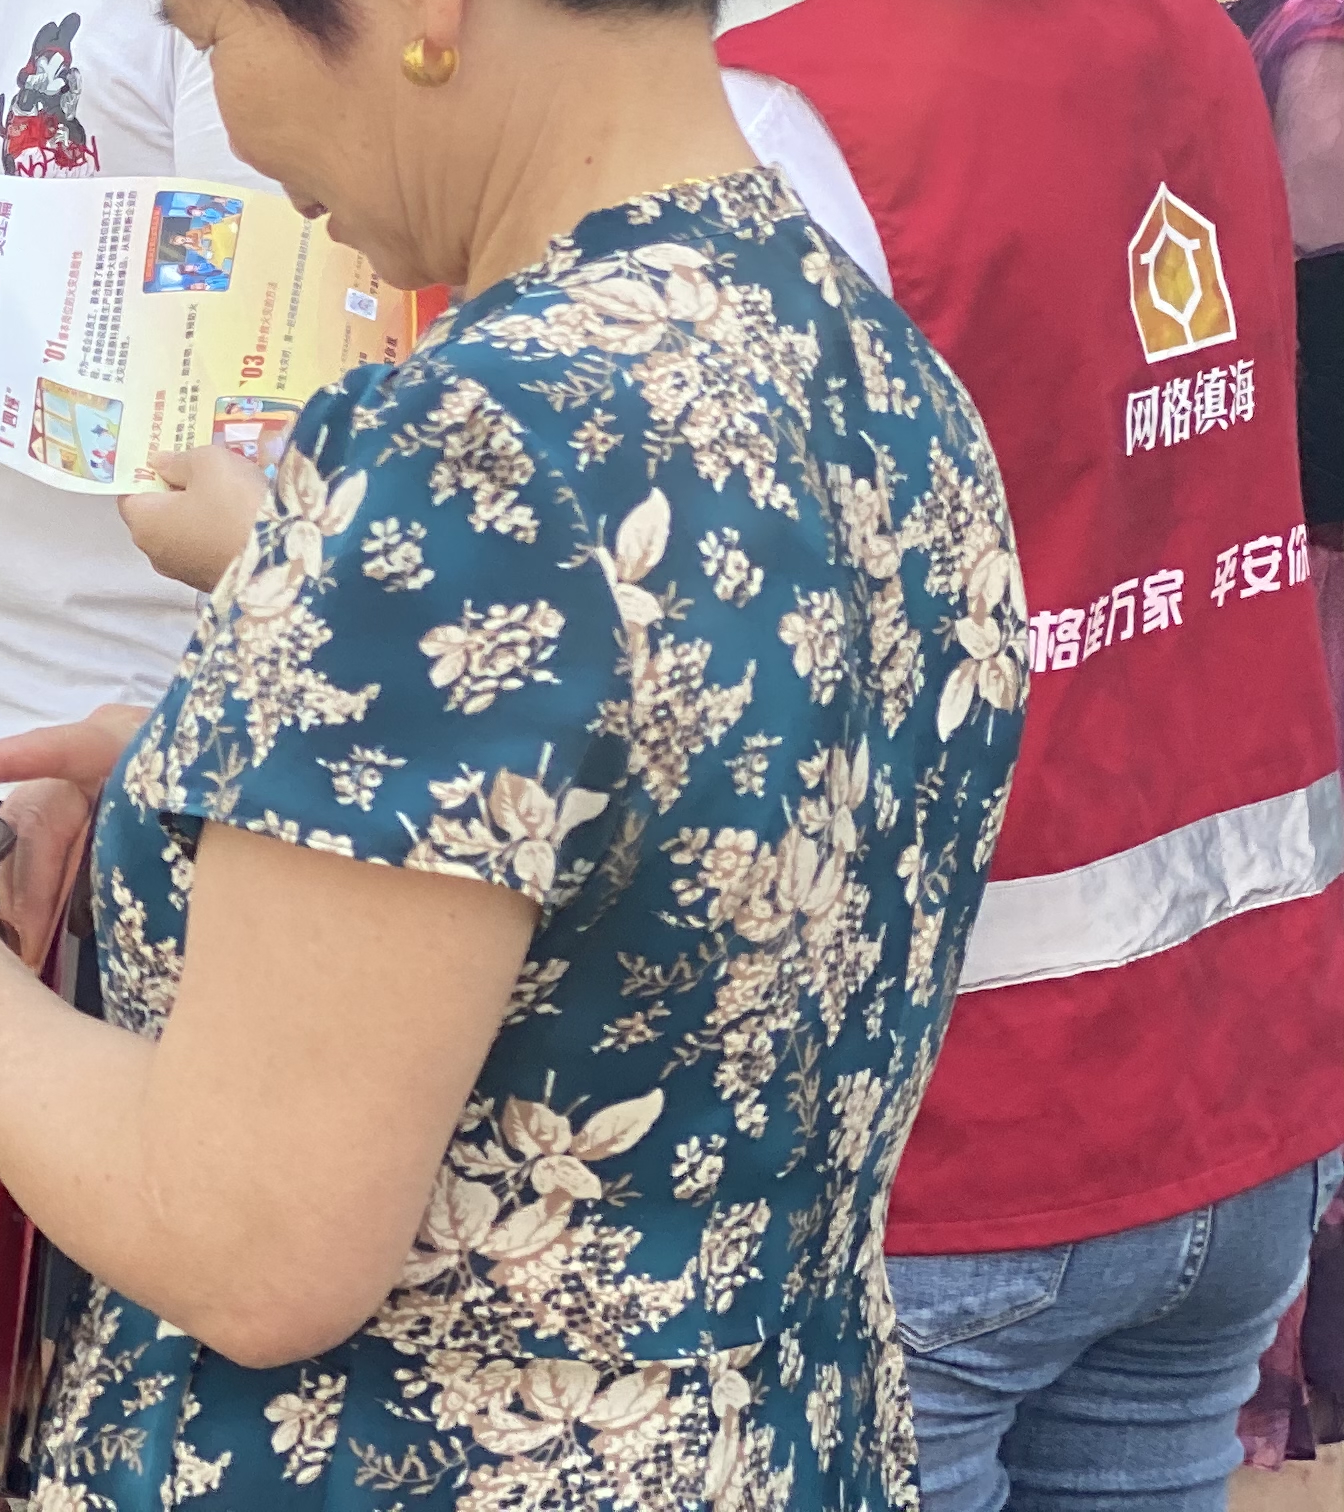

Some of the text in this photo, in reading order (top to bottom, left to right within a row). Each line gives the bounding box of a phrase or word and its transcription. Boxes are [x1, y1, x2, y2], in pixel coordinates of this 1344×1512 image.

[242, 352, 265, 379] 03
[1125, 359, 1255, 456] 网格镇海
